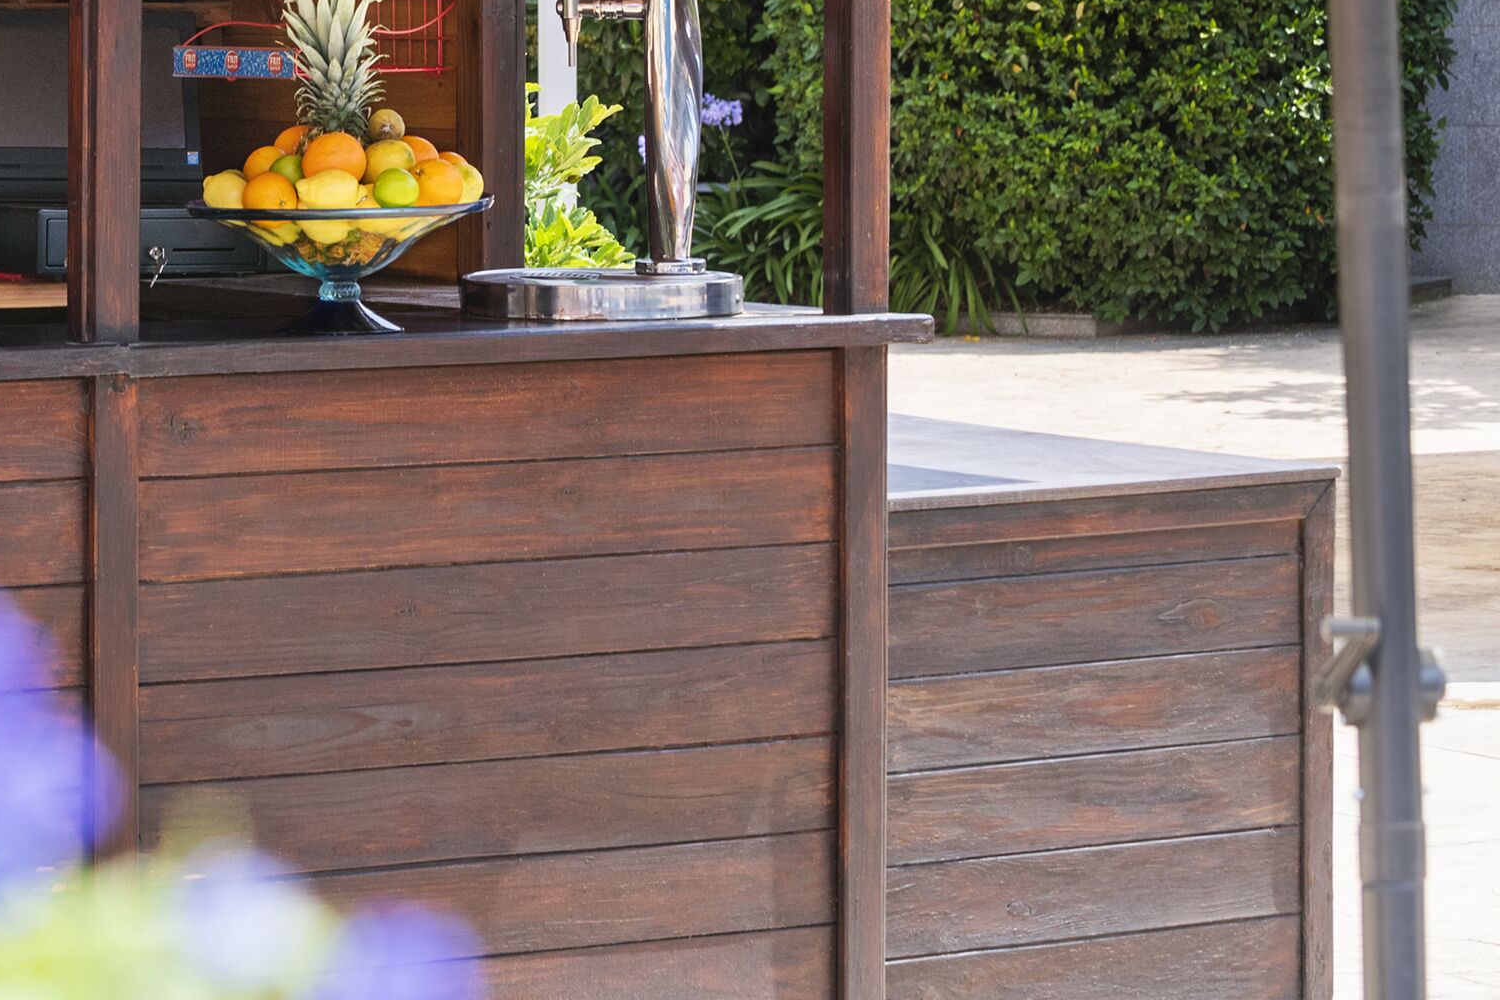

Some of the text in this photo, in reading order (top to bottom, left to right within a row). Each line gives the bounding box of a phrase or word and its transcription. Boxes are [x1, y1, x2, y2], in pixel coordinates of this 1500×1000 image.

[185, 53, 196, 63] FRIT
[227, 54, 239, 63] FRIT
[269, 55, 281, 65] FRIT
